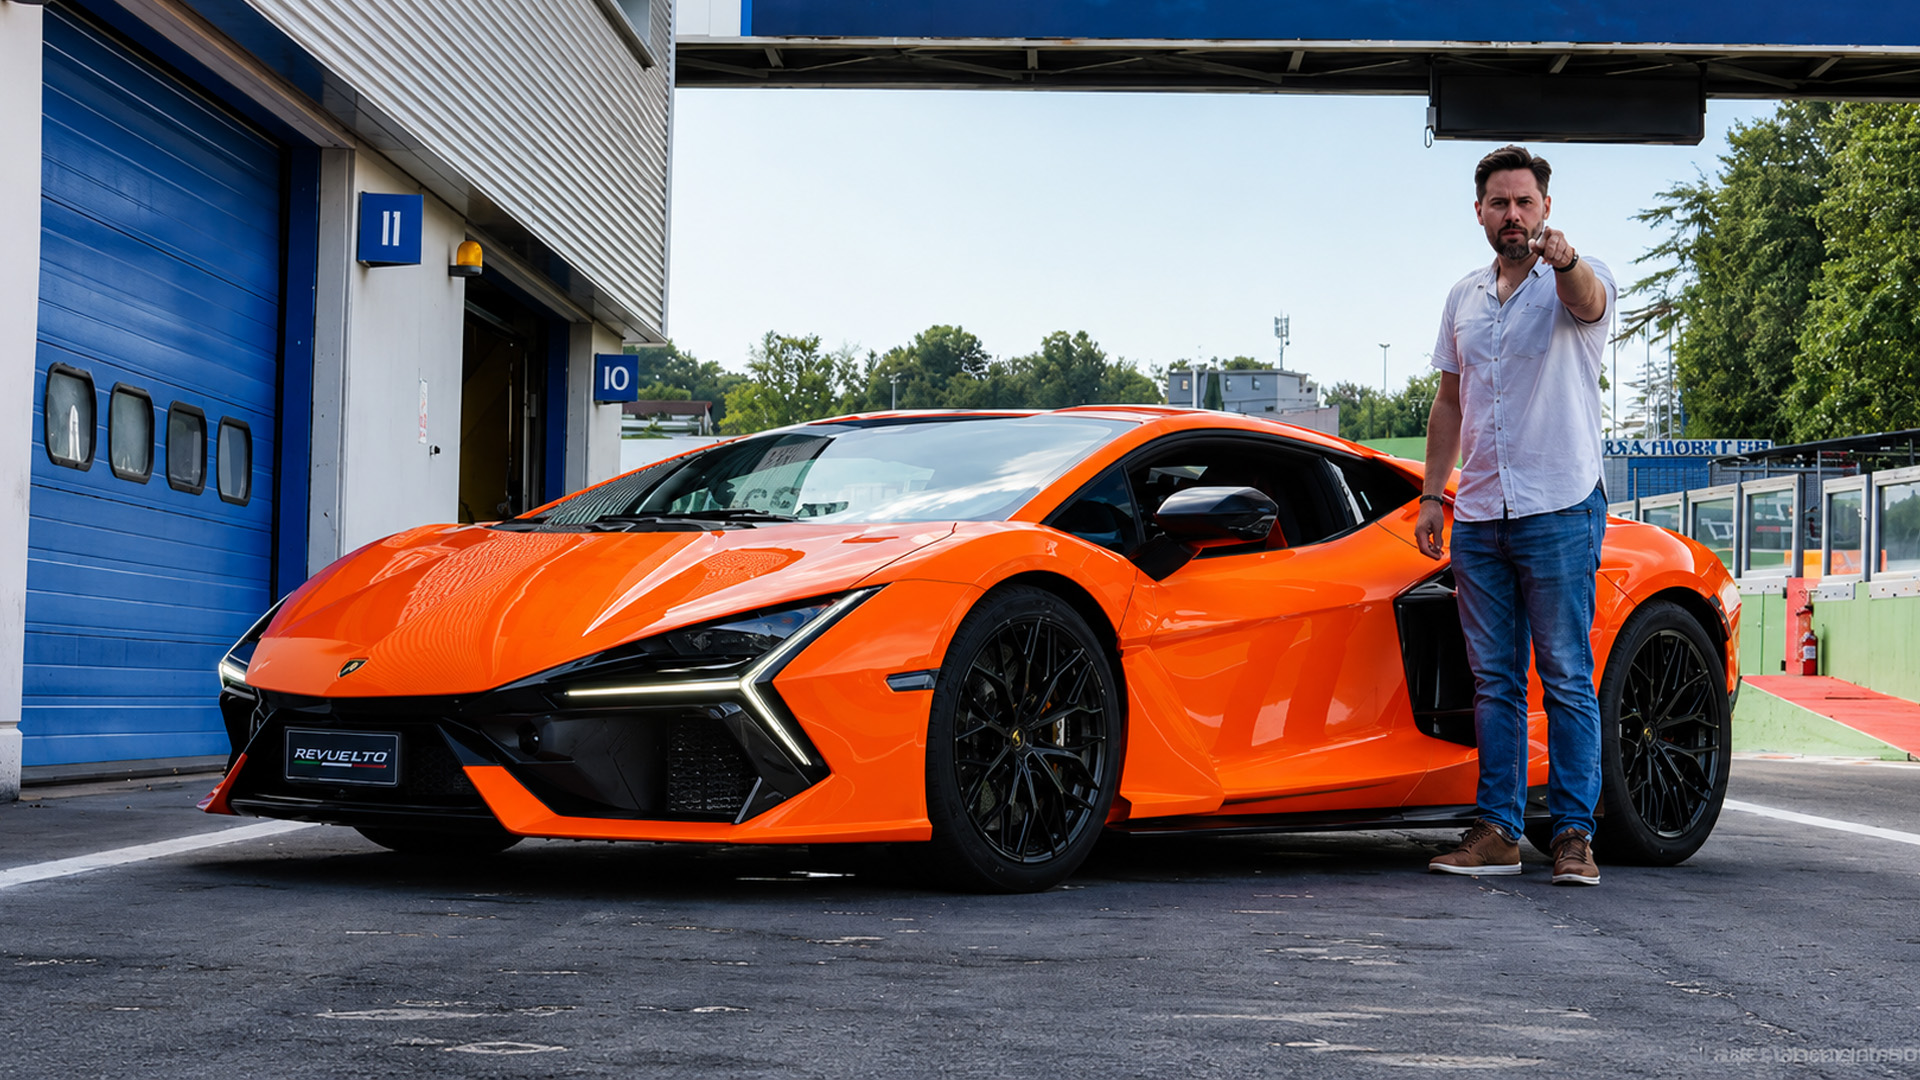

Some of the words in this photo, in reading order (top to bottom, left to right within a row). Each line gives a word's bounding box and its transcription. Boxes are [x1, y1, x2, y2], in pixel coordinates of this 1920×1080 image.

[382, 211, 401, 246] 11
[604, 366, 629, 391] 10
[294, 748, 388, 763] REVUELTO
